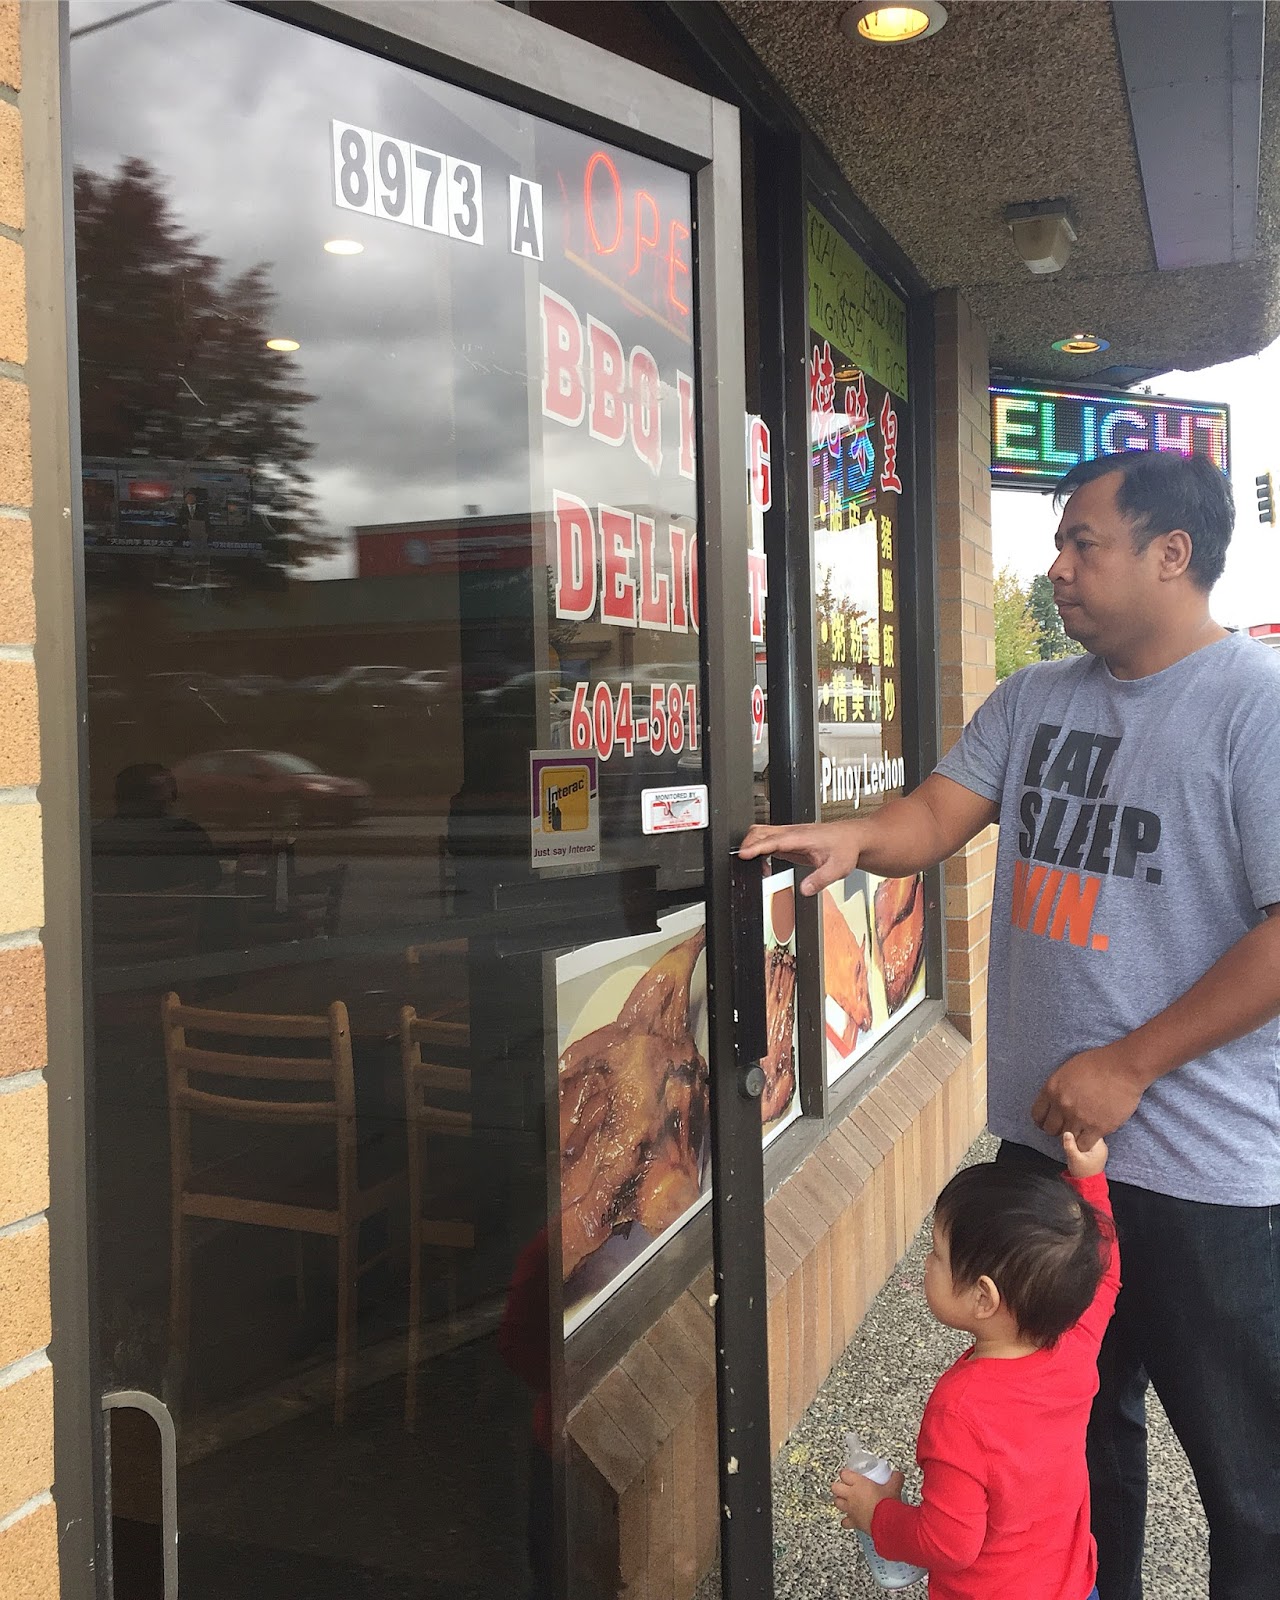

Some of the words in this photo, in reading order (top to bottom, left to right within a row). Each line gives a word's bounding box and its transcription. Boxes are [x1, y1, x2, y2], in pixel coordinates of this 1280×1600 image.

[339, 128, 478, 238] 8973
[513, 182, 540, 257] A
[539, 282, 664, 478] BBQ
[547, 777, 585, 811] Interac
[655, 792, 688, 801] MONITORED
[821, 756, 861, 810] Pinoy
[863, 749, 905, 796] Lechon
[533, 848, 550, 858] Just
[552, 847, 567, 857] say
[568, 844, 596, 854] Interac
